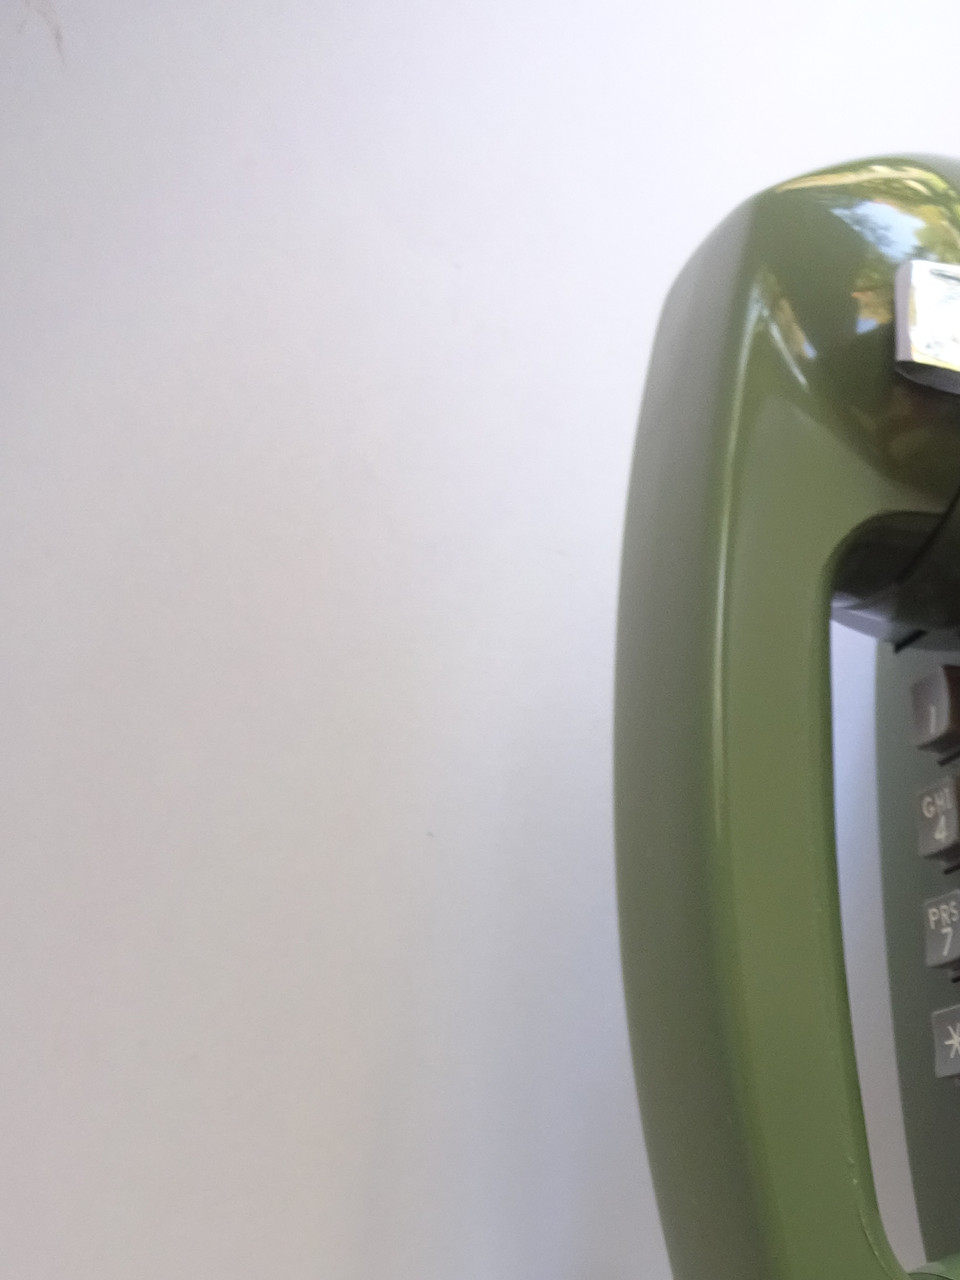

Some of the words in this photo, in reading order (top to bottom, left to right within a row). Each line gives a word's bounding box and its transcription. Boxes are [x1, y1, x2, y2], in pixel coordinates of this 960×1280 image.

[934, 813, 947, 840] 4
[928, 901, 960, 930] PRS
[941, 926, 953, 957] 7
